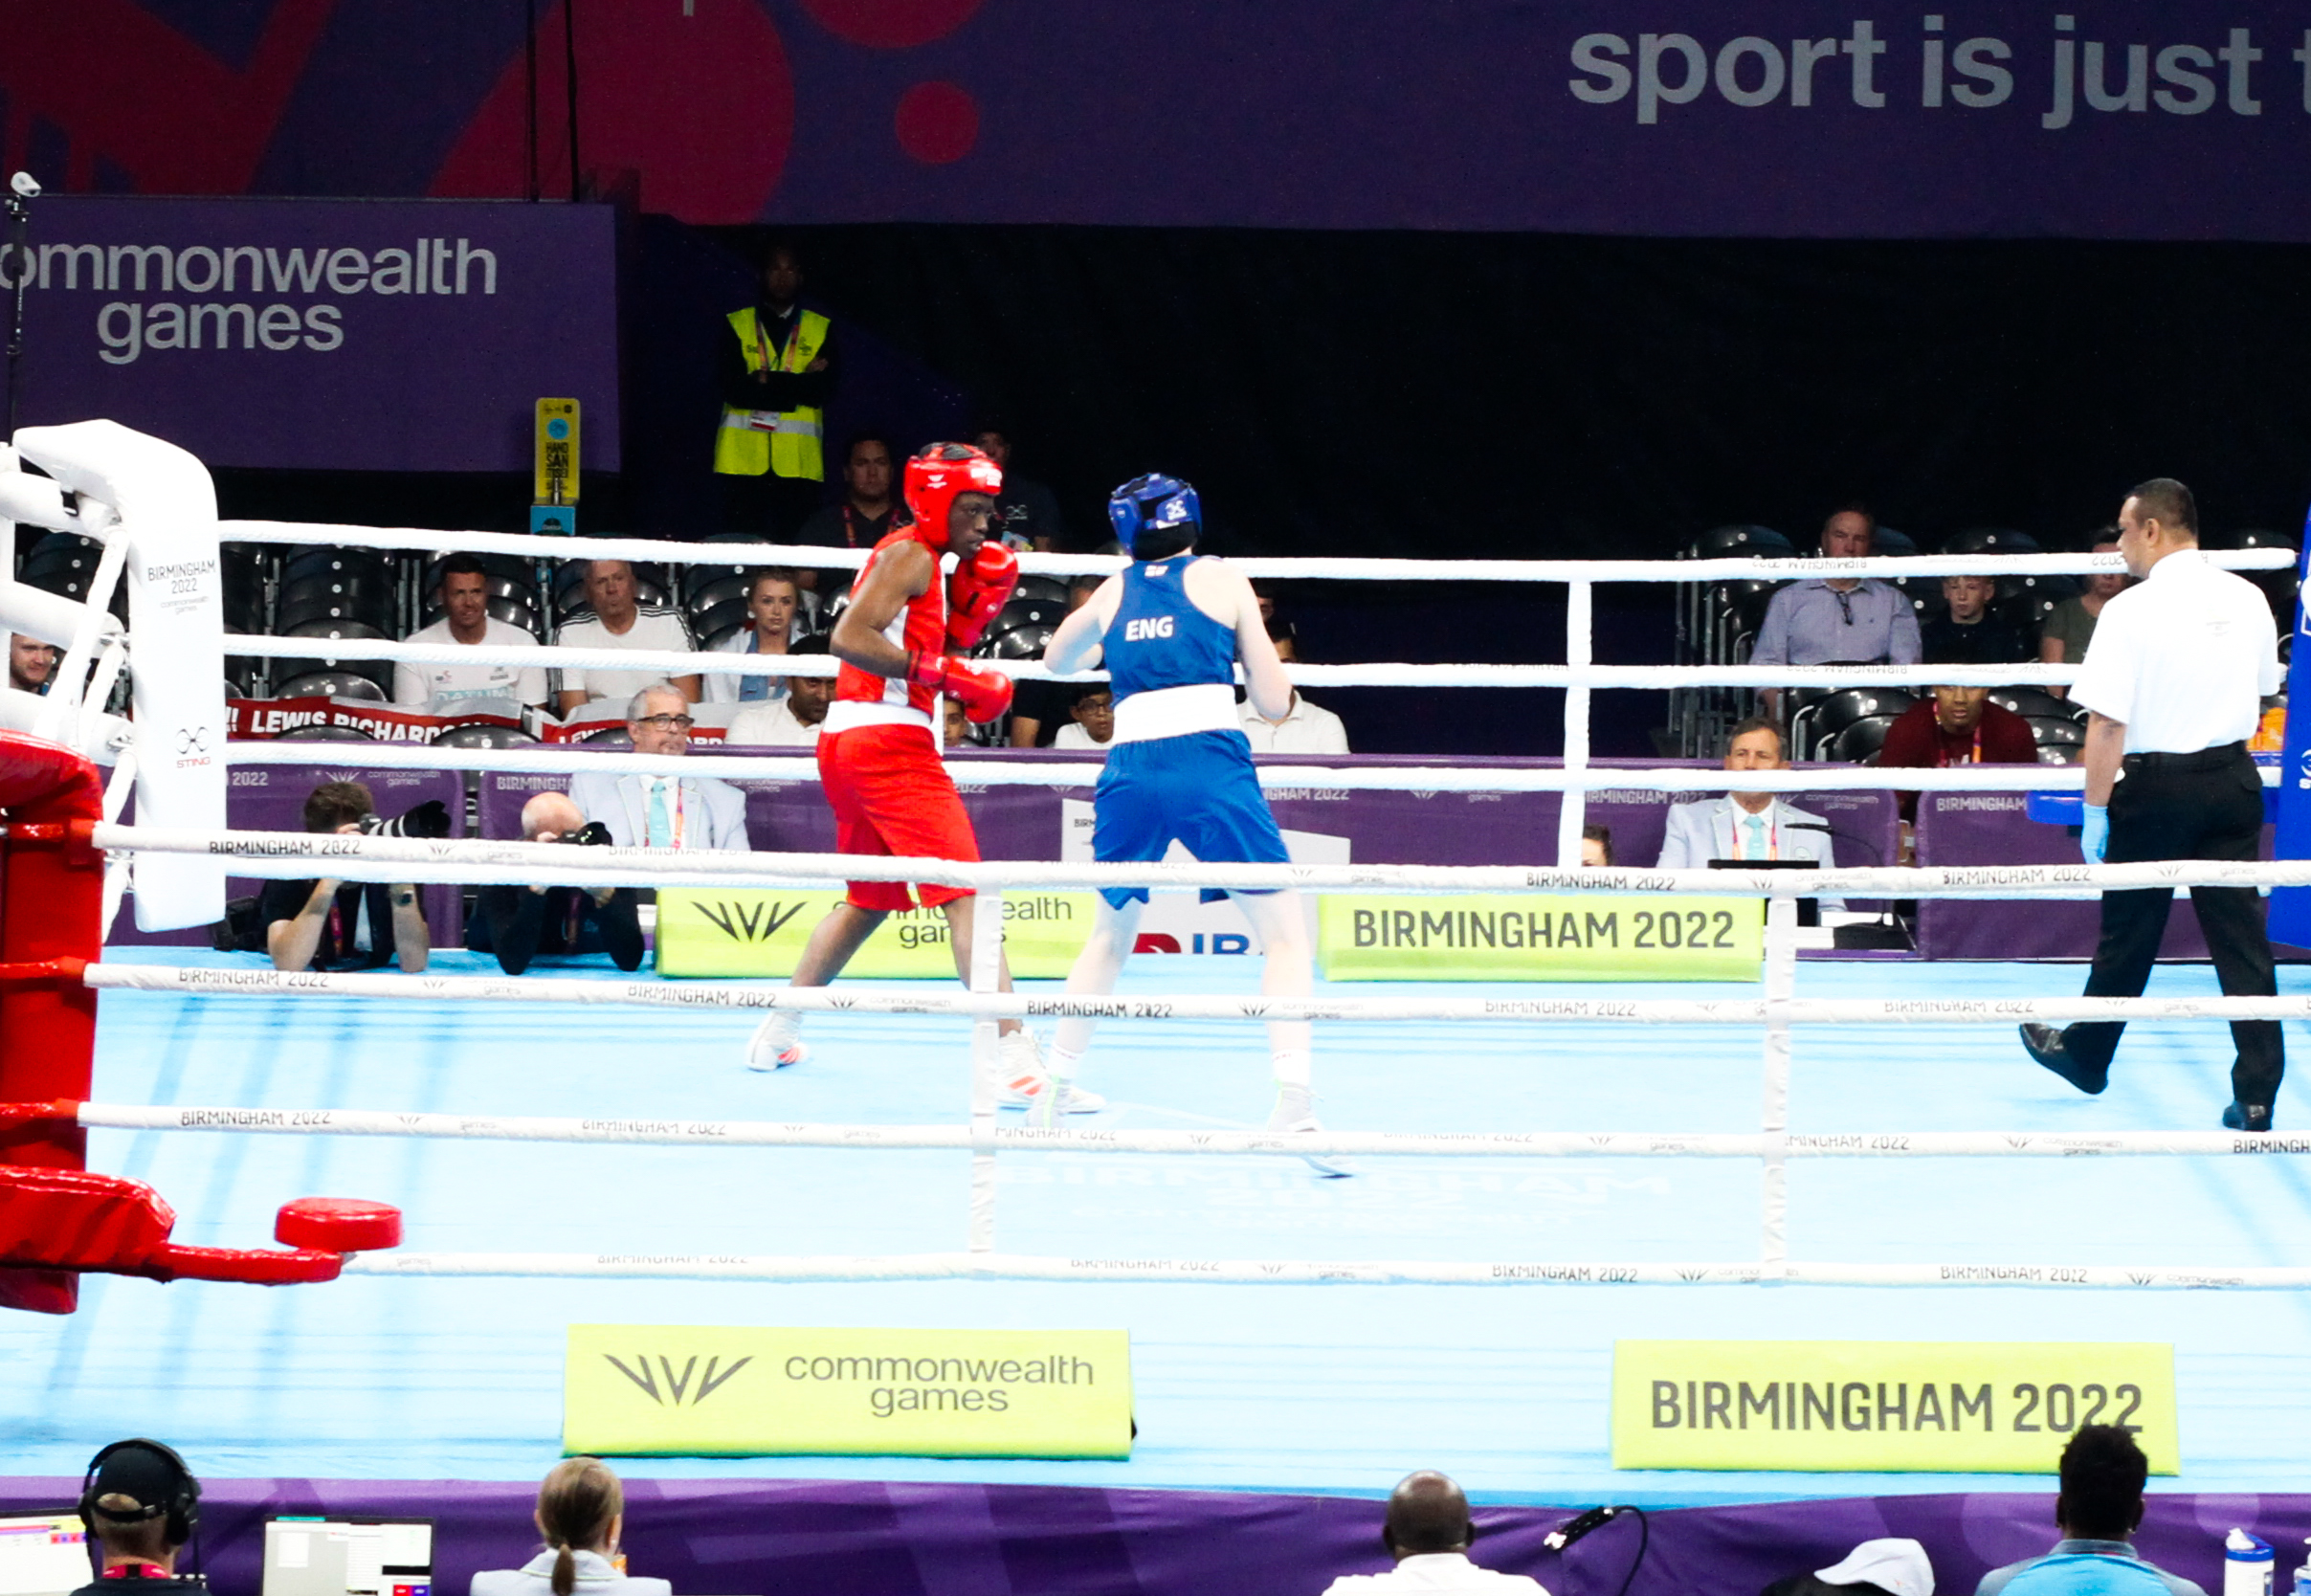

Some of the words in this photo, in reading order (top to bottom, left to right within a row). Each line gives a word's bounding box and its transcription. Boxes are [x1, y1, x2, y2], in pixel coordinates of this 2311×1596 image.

[1568, 19, 1886, 125] sport
[1921, 13, 2014, 109] is
[2041, 13, 2262, 130] just
[97, 301, 344, 366] games
[147, 559, 216, 582] BIRMINGHAM
[171, 577, 199, 594] 2022
[1124, 615, 1173, 642] ENG
[251, 710, 327, 733] LEWIS
[176, 756, 211, 768] STING
[233, 771, 269, 787] 2022
[1585, 789, 1667, 804] IRMINGHAM
[1936, 796, 2028, 812] BIRMINGHAM
[210, 840, 313, 855] BIRMINGHAM
[322, 839, 361, 855] 2022
[1526, 872, 1627, 890] BIRMINGHAM
[1635, 875, 1676, 892] 2022
[1942, 868, 2045, 885] BIRMINGHAM
[2054, 866, 2091, 882] 2022
[1353, 909, 1619, 949] BIRMINGHAM
[1633, 910, 1736, 949] 2022
[179, 968, 279, 986] BIRMINGHAM
[288, 973, 329, 987] 2022
[628, 984, 729, 1006] BIRMINGHAM
[738, 990, 776, 1009] 2022
[1028, 1000, 1127, 1018] BIRMINGHAM
[1135, 1003, 1172, 1018] 2022
[1485, 1000, 1589, 1014] BIRMINGHAM
[1596, 1001, 1635, 1017] 2022
[180, 1110, 284, 1127] BIRMINGHAM
[292, 1110, 332, 1126] 2022
[1871, 1136, 1910, 1150] 2022
[1493, 1264, 1591, 1282] BIRMINGHAM
[1599, 1267, 1638, 1283] 2022
[1941, 1265, 2042, 1282] BIRMINGHAM
[785, 1354, 1094, 1385] commonwealth
[870, 1385, 1009, 1418] games
[1651, 1380, 1993, 1432] BIRMINGHAM
[2012, 1382, 2144, 1433] 2022
